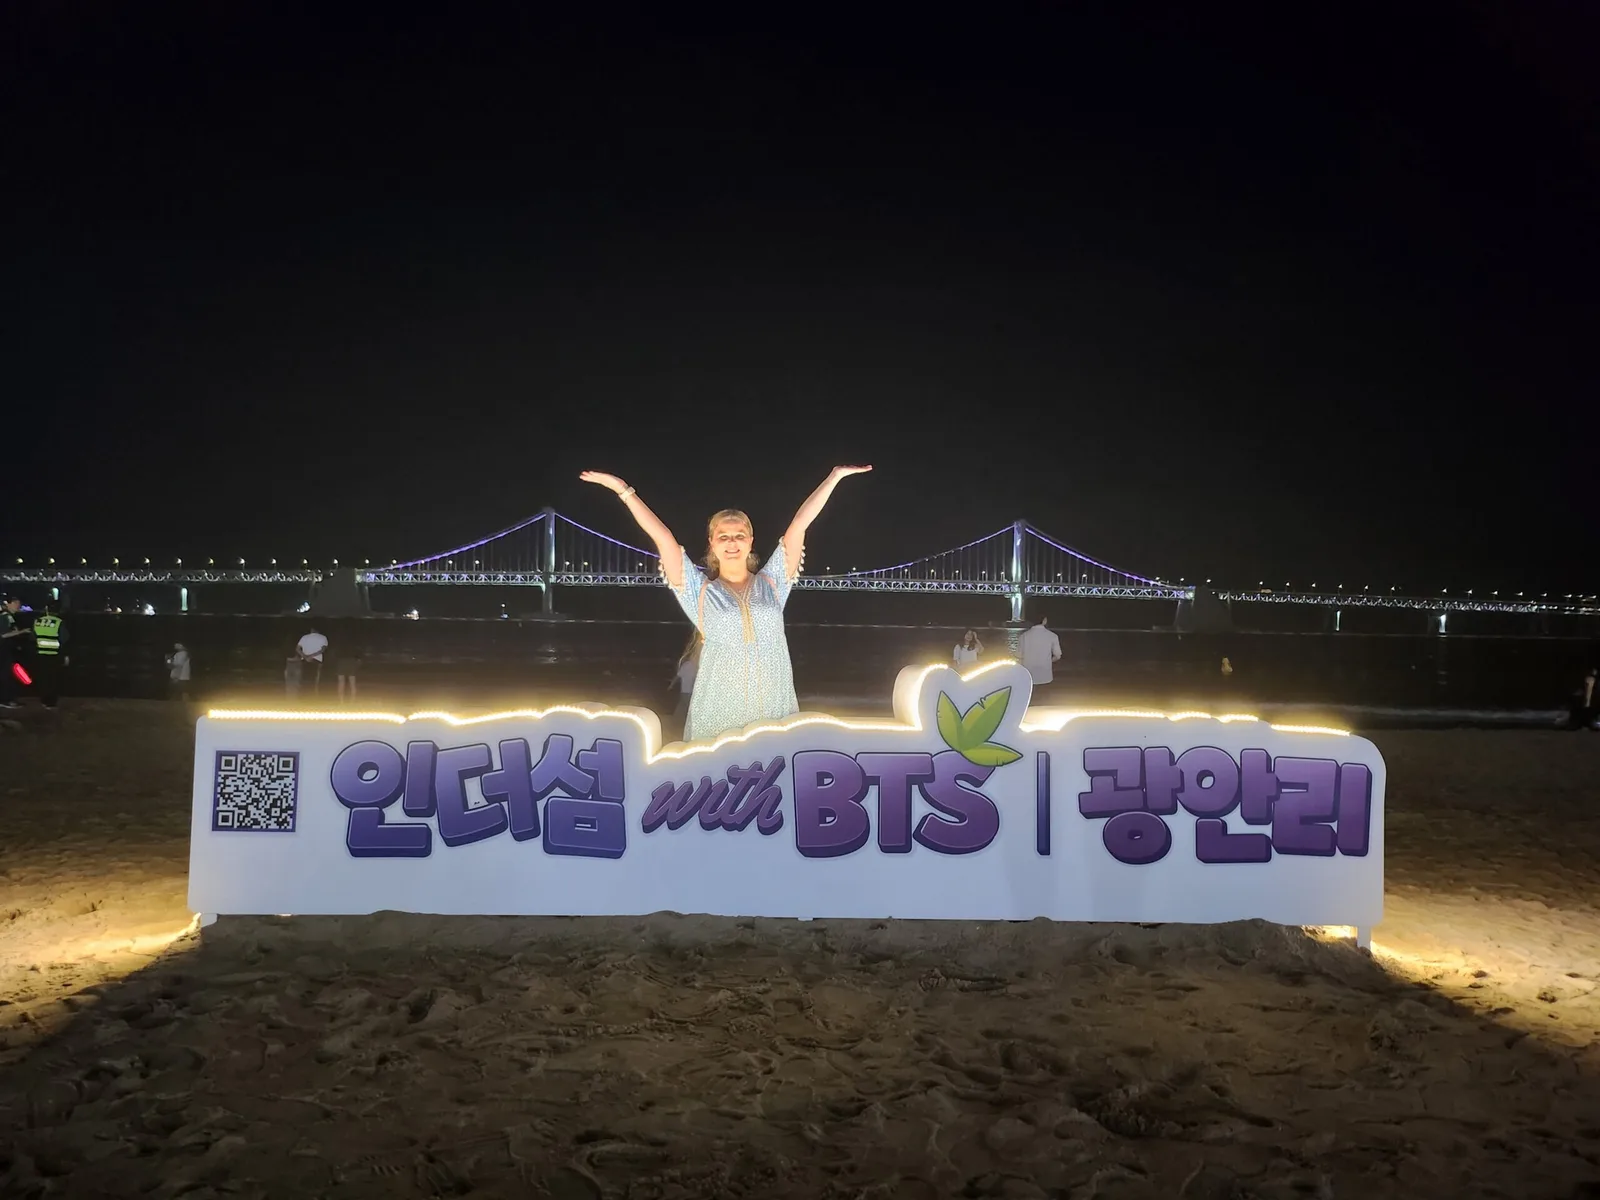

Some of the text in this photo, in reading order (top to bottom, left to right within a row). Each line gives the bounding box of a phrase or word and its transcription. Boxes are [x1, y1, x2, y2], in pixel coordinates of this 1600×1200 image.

[331, 734, 1372, 865] 인더섬 with BTS 광안리
